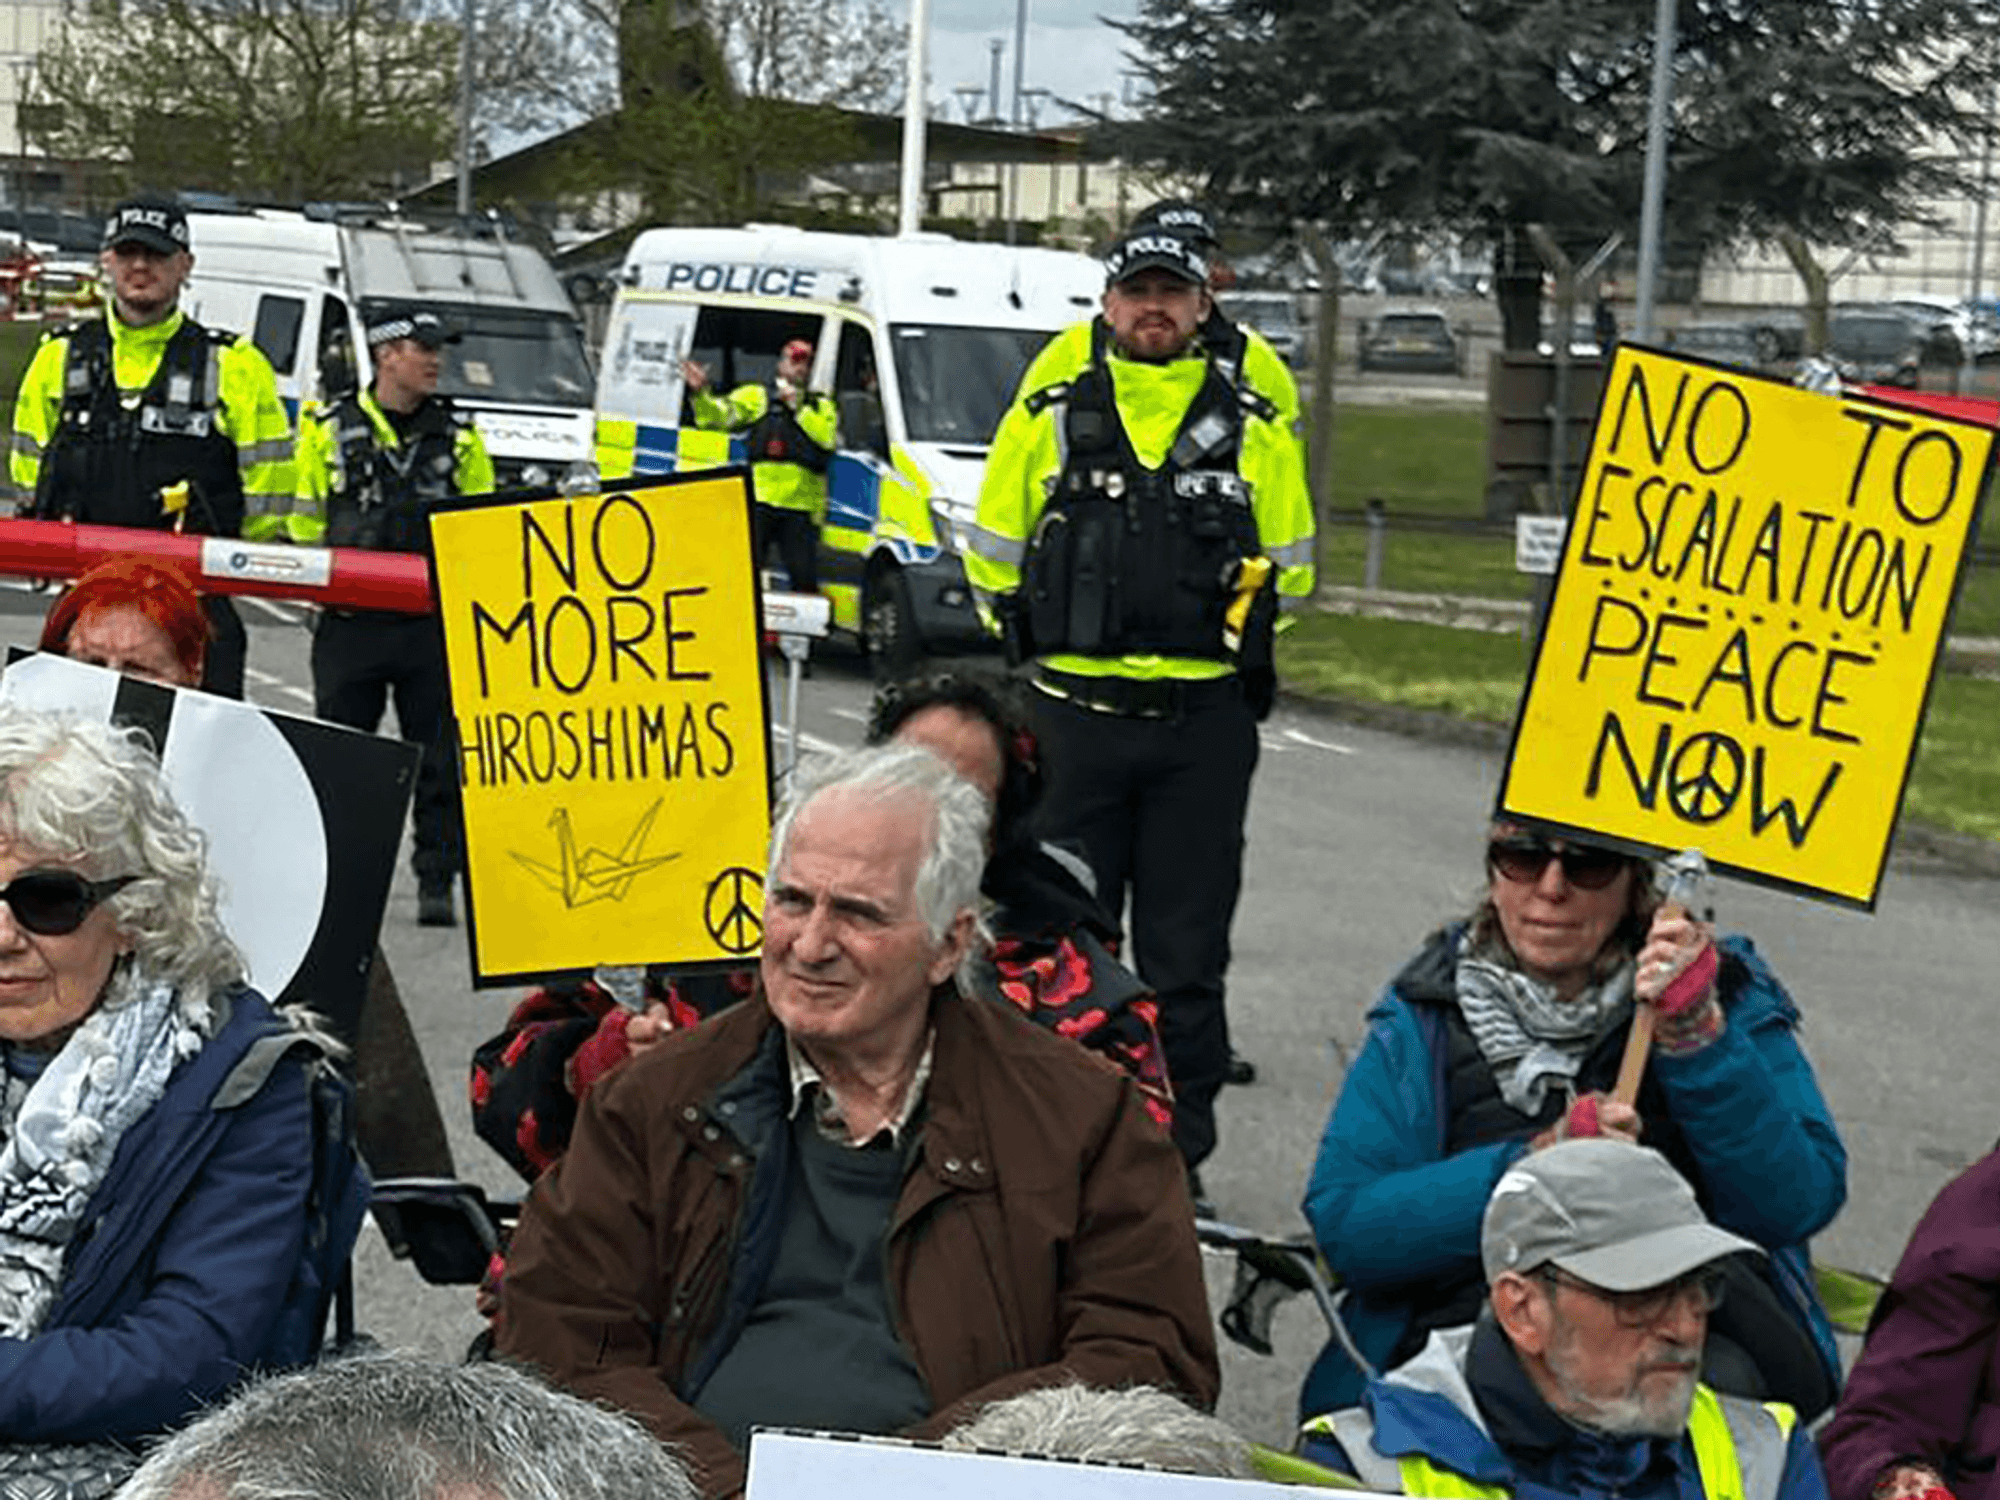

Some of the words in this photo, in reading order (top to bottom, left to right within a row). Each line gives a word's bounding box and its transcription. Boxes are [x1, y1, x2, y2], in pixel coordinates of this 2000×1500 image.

[665, 263, 817, 298] POLICE
[1125, 237, 1184, 258] POLICE
[1607, 363, 1750, 475] NO
[1841, 407, 1962, 525] TO
[521, 494, 656, 599] NO
[1580, 464, 1932, 633] ESCALATION
[471, 587, 712, 698] MORE
[1578, 595, 1877, 747] PEACE
[458, 702, 735, 789] HIROSHIMAS
[1584, 710, 1844, 850] NOW
